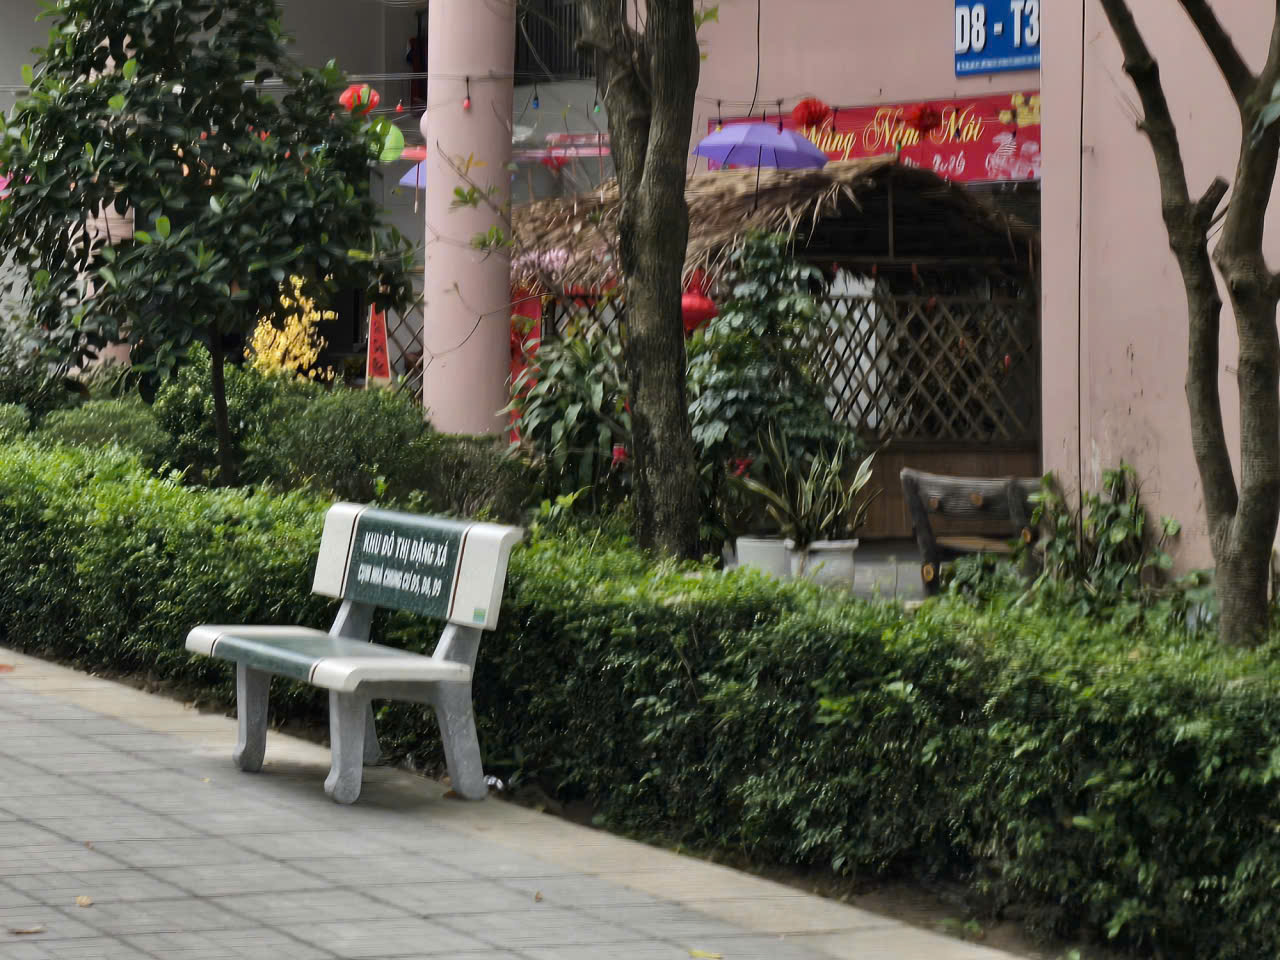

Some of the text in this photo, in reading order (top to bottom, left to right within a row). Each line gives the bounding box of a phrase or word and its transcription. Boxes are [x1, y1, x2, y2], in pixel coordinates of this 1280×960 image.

[955, 3, 986, 54] D8
[930, 103, 985, 144] Mới
[363, 530, 449, 569] KHU ĐÔ THỊ ĐẶNG XÁ
